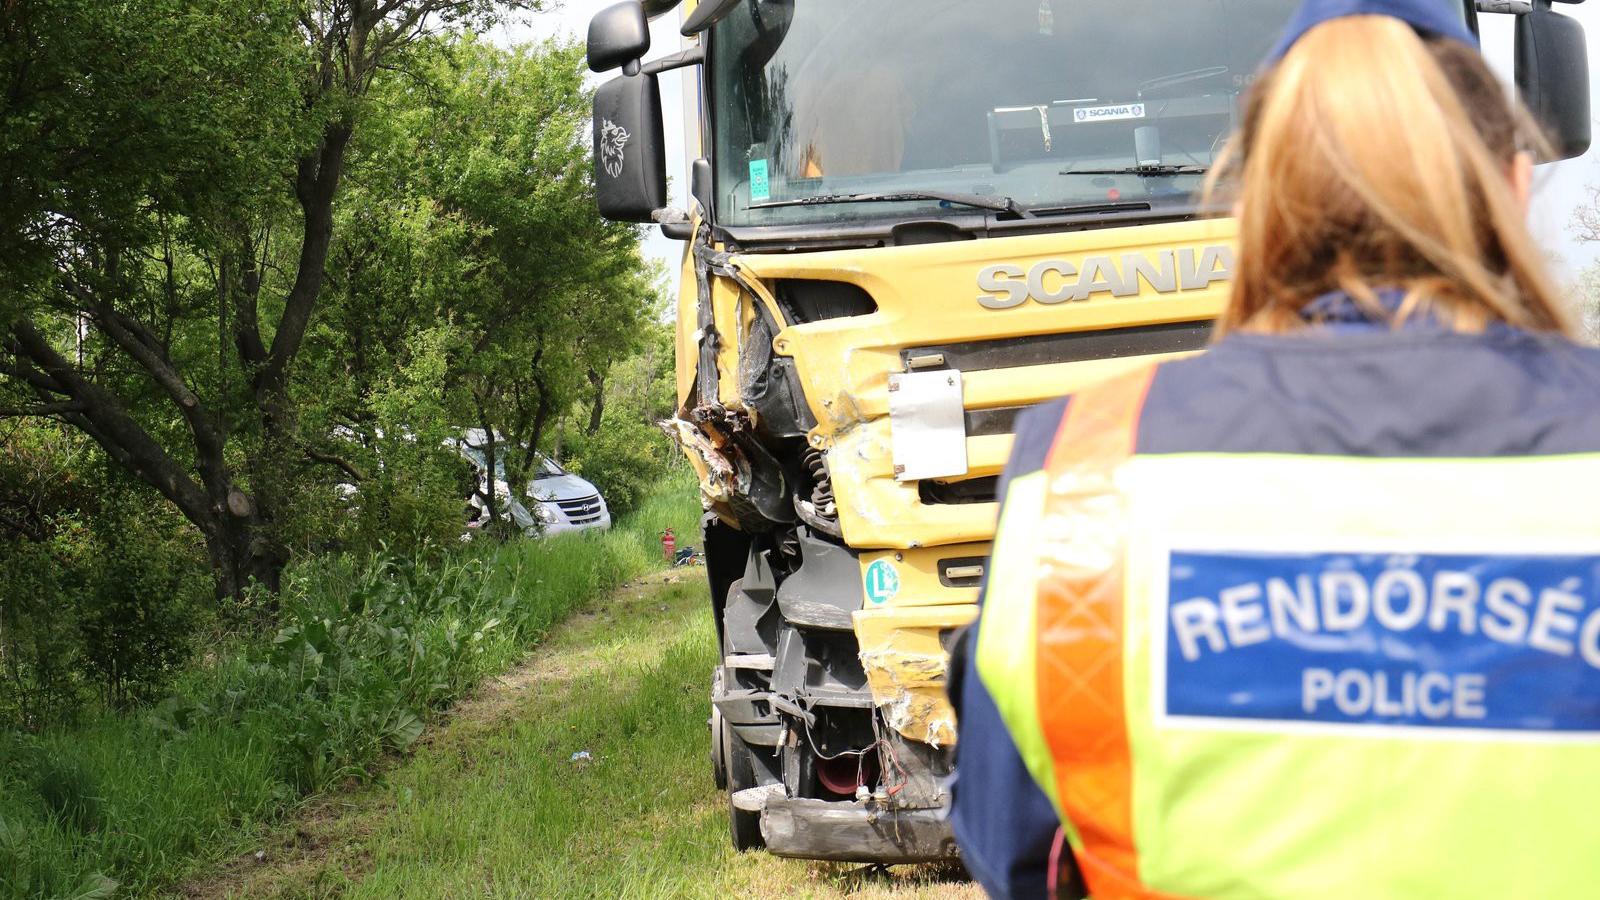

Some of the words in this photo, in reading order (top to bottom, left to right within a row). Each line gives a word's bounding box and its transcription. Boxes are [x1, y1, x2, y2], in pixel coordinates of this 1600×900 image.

[1089, 107, 1129, 117] SCANIA
[976, 245, 1236, 310] SCANIA
[1302, 667, 1488, 720] POLICE
